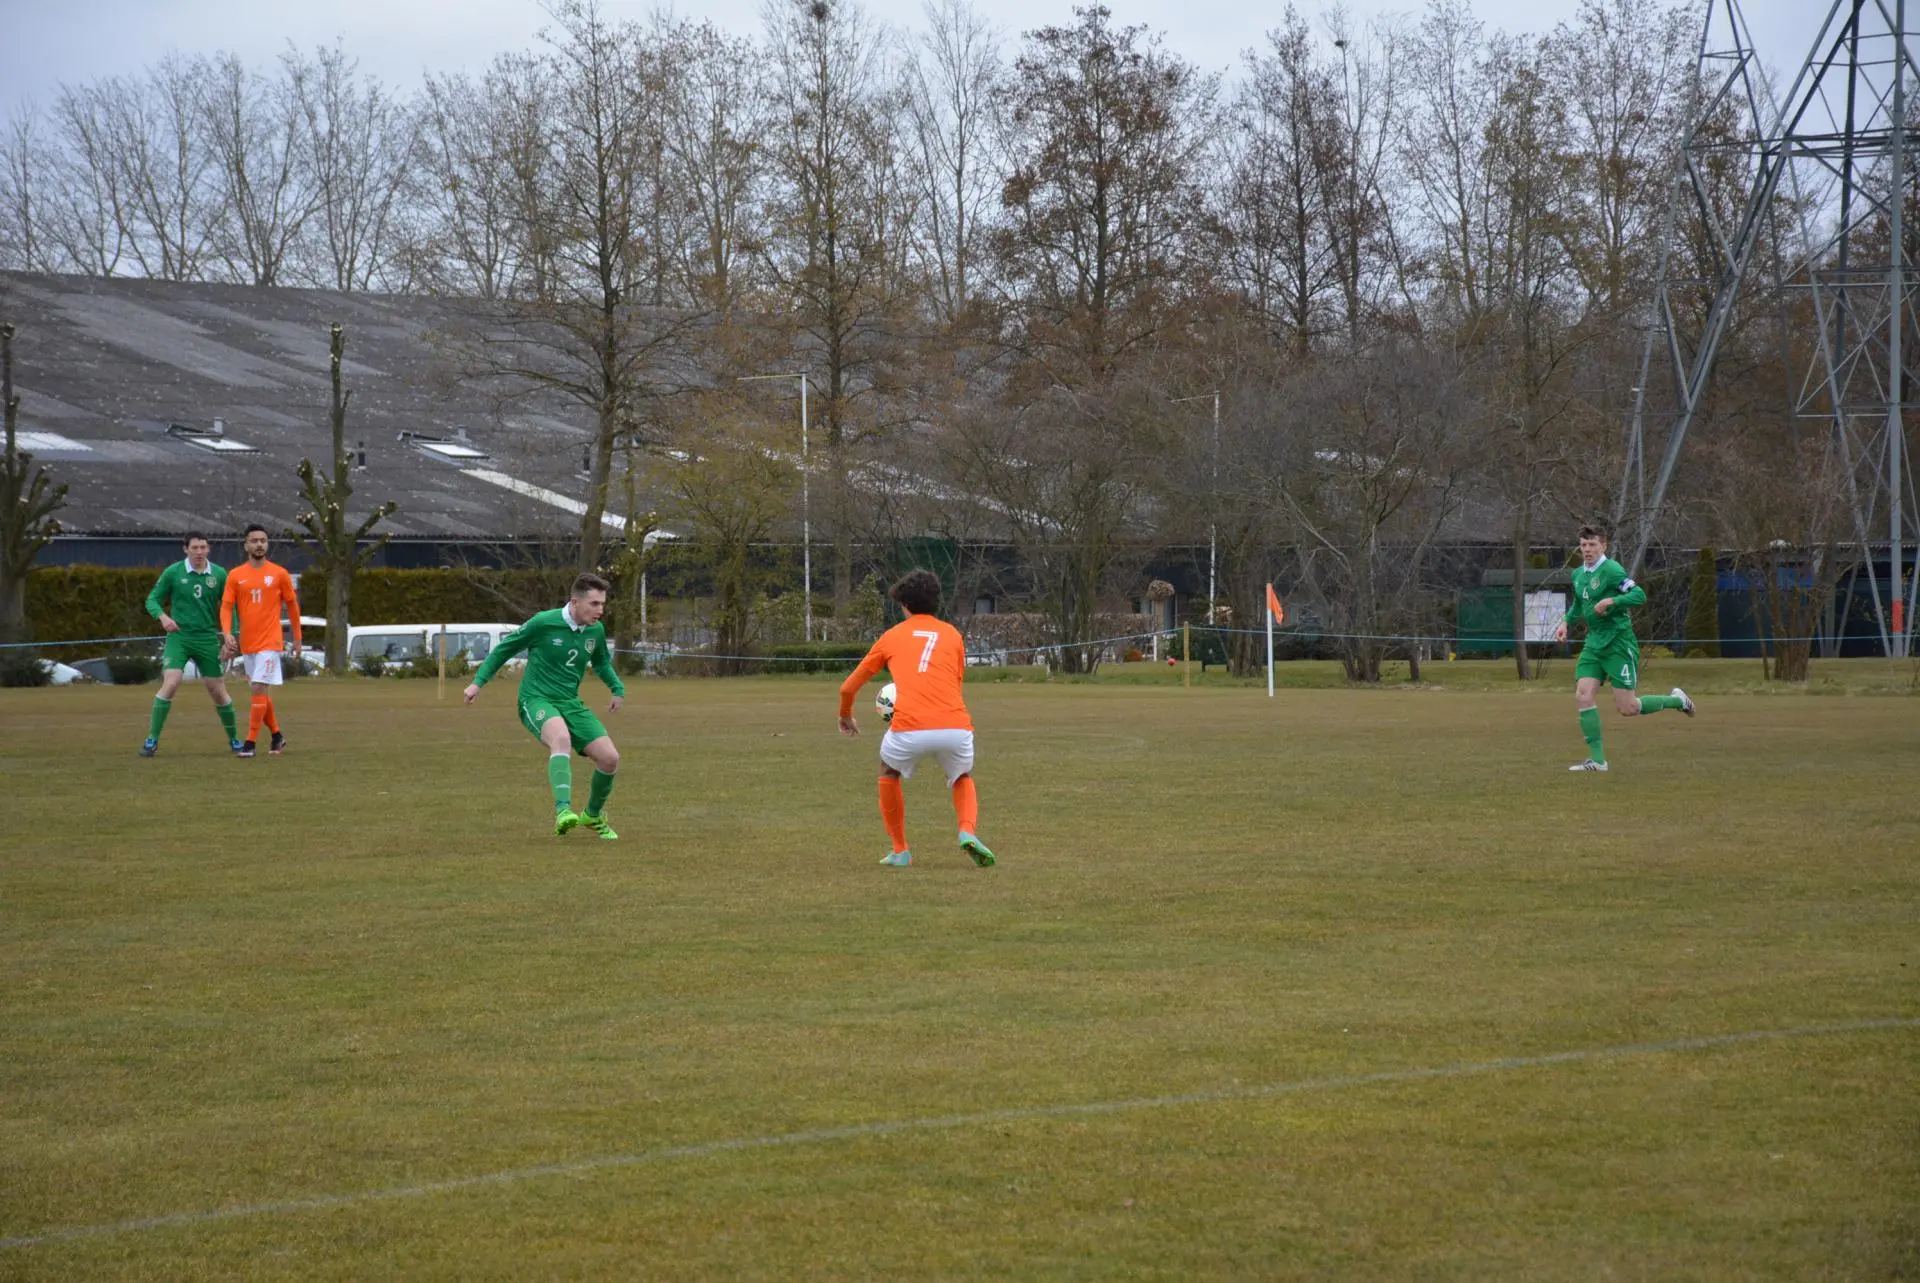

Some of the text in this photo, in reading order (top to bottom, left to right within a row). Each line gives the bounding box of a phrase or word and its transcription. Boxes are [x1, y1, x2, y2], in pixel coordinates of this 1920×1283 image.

[193, 584, 202, 599] 3
[250, 588, 262, 604] 11
[1582, 587, 1590, 600] 4
[565, 649, 579, 667] 2
[912, 630, 938, 673] 7
[1621, 663, 1630, 681] 4
